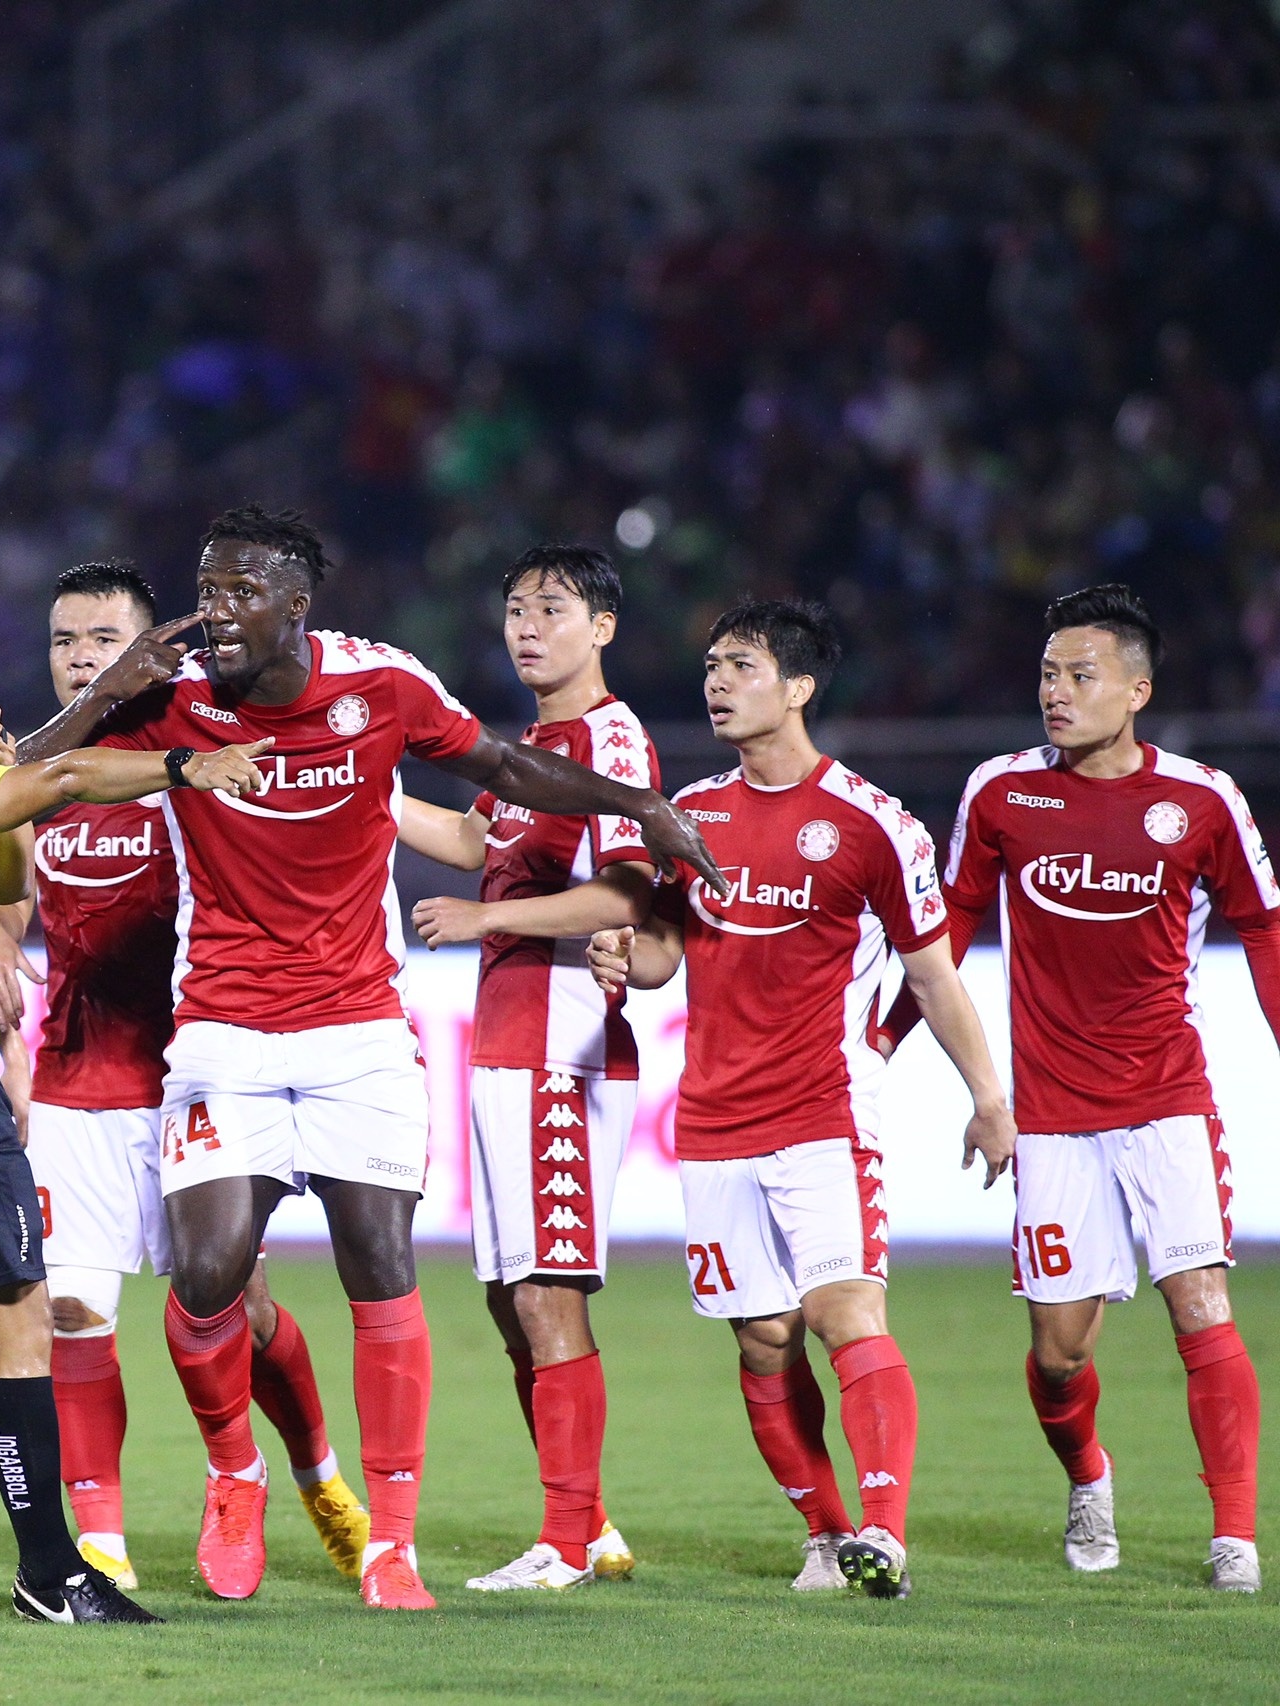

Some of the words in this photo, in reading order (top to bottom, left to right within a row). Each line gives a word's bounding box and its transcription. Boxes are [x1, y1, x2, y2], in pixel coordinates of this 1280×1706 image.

[191, 701, 242, 728] Kapp
[1007, 791, 1065, 810] Kappa
[366, 1156, 419, 1178] Kappa
[16, 1204, 29, 1263] JOGARBOLA
[1022, 1222, 1072, 1280] 16
[1165, 1239, 1219, 1259] Kappa
[686, 1241, 737, 1296] 21
[803, 1255, 853, 1280] Kappa
